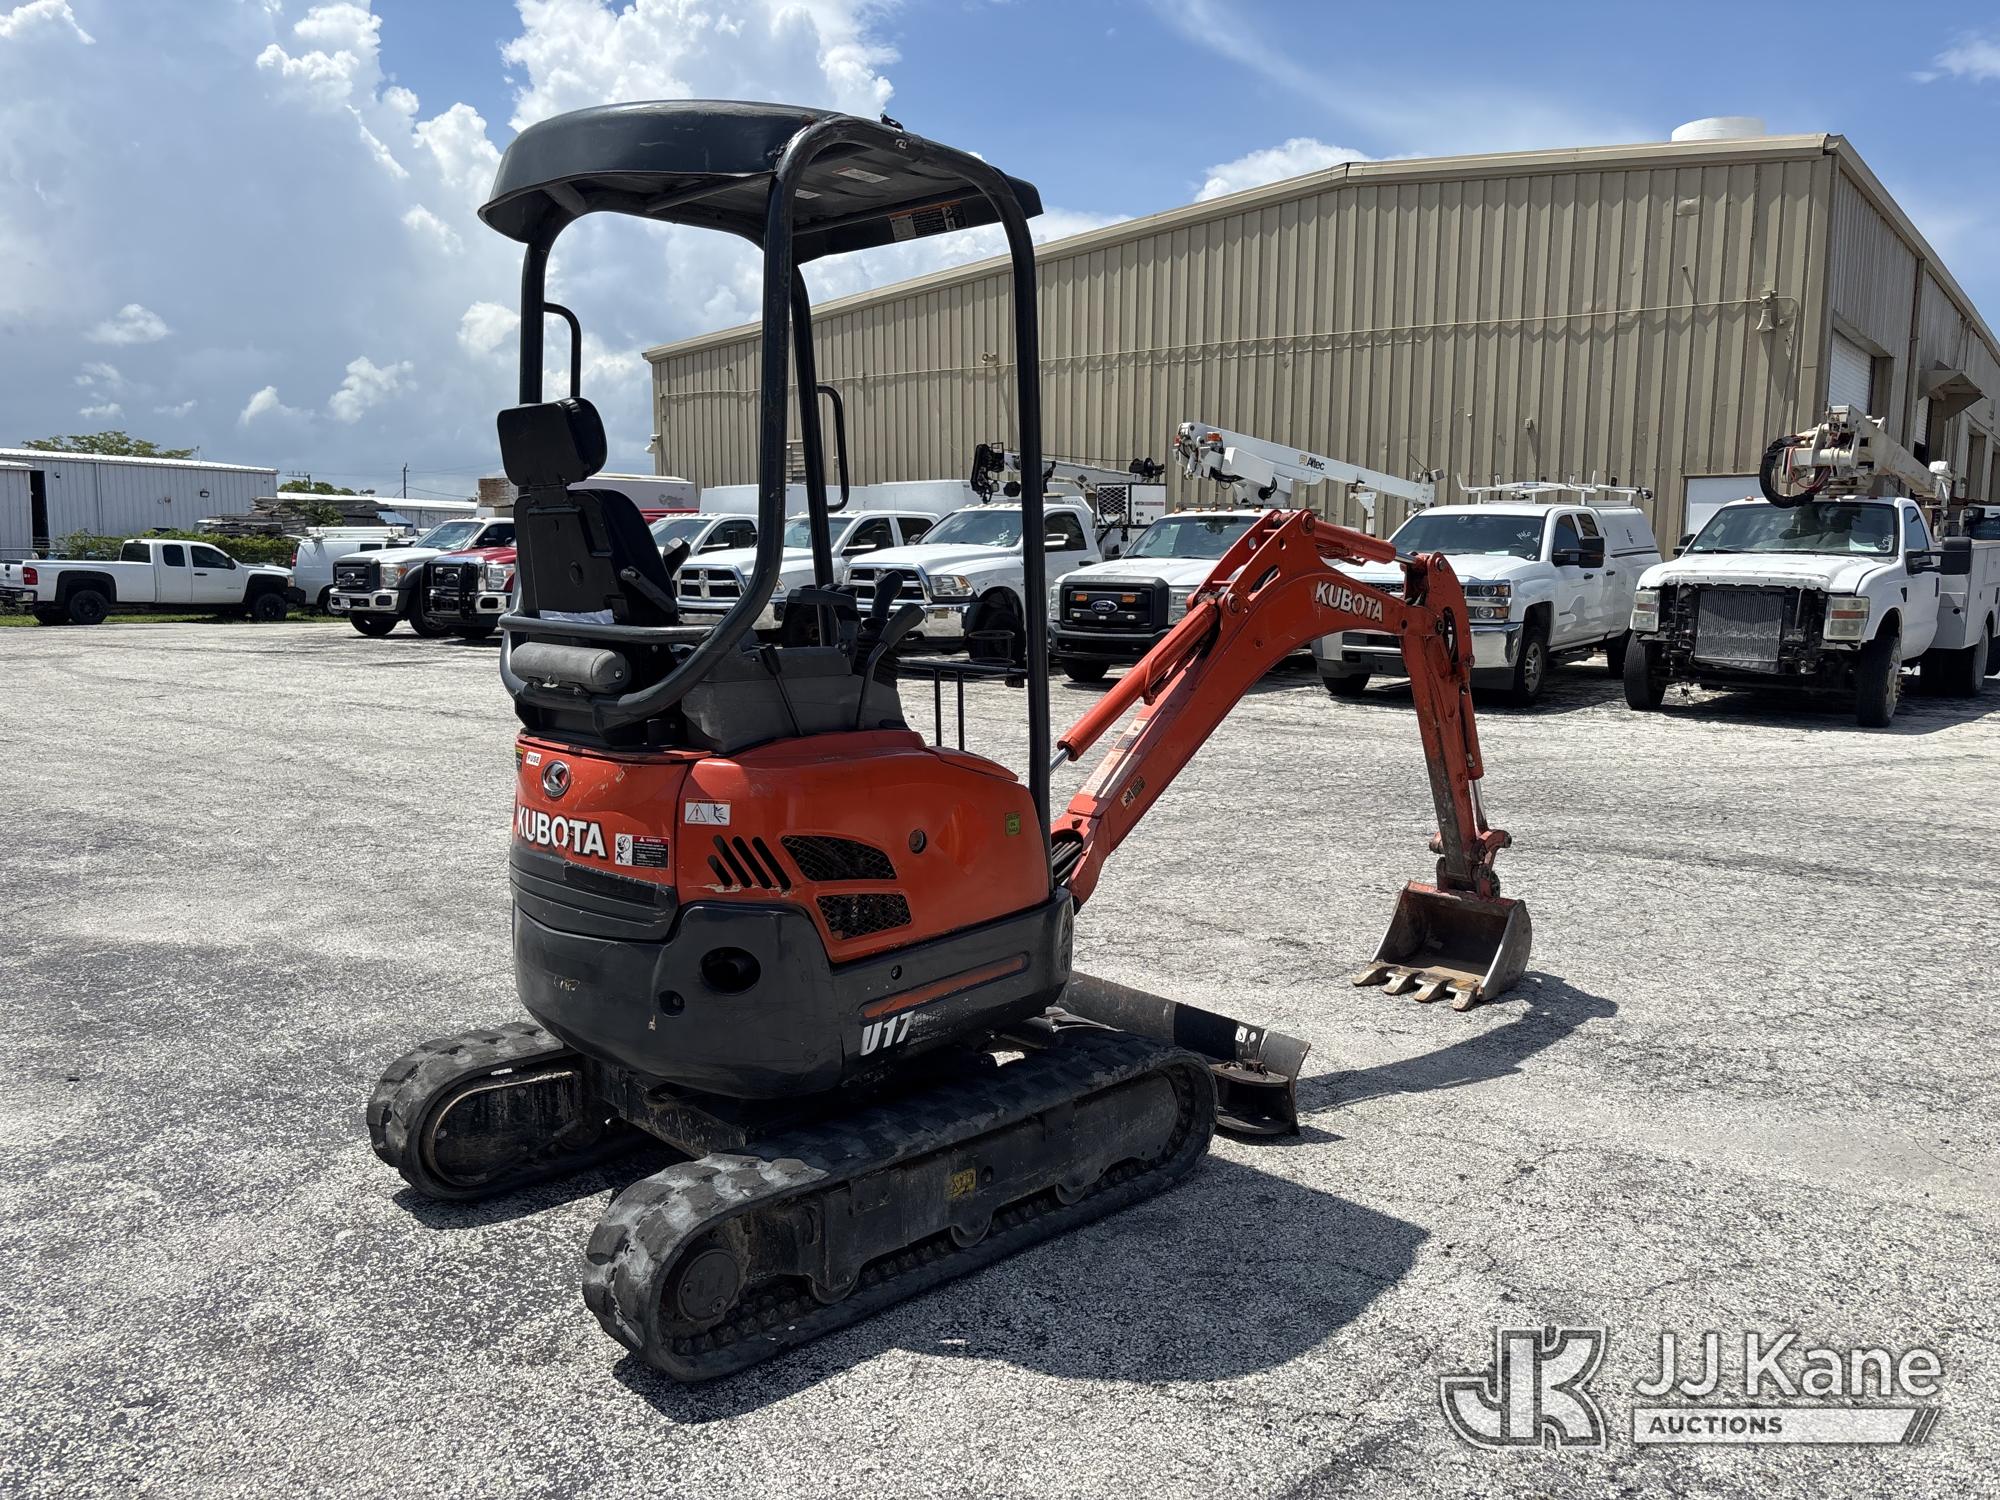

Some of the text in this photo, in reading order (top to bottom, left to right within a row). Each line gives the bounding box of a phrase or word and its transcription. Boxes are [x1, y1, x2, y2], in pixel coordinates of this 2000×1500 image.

[1315, 581, 1383, 622] KUBOTA
[516, 804, 607, 858] KUBOTA
[860, 1010, 916, 1056] U17
